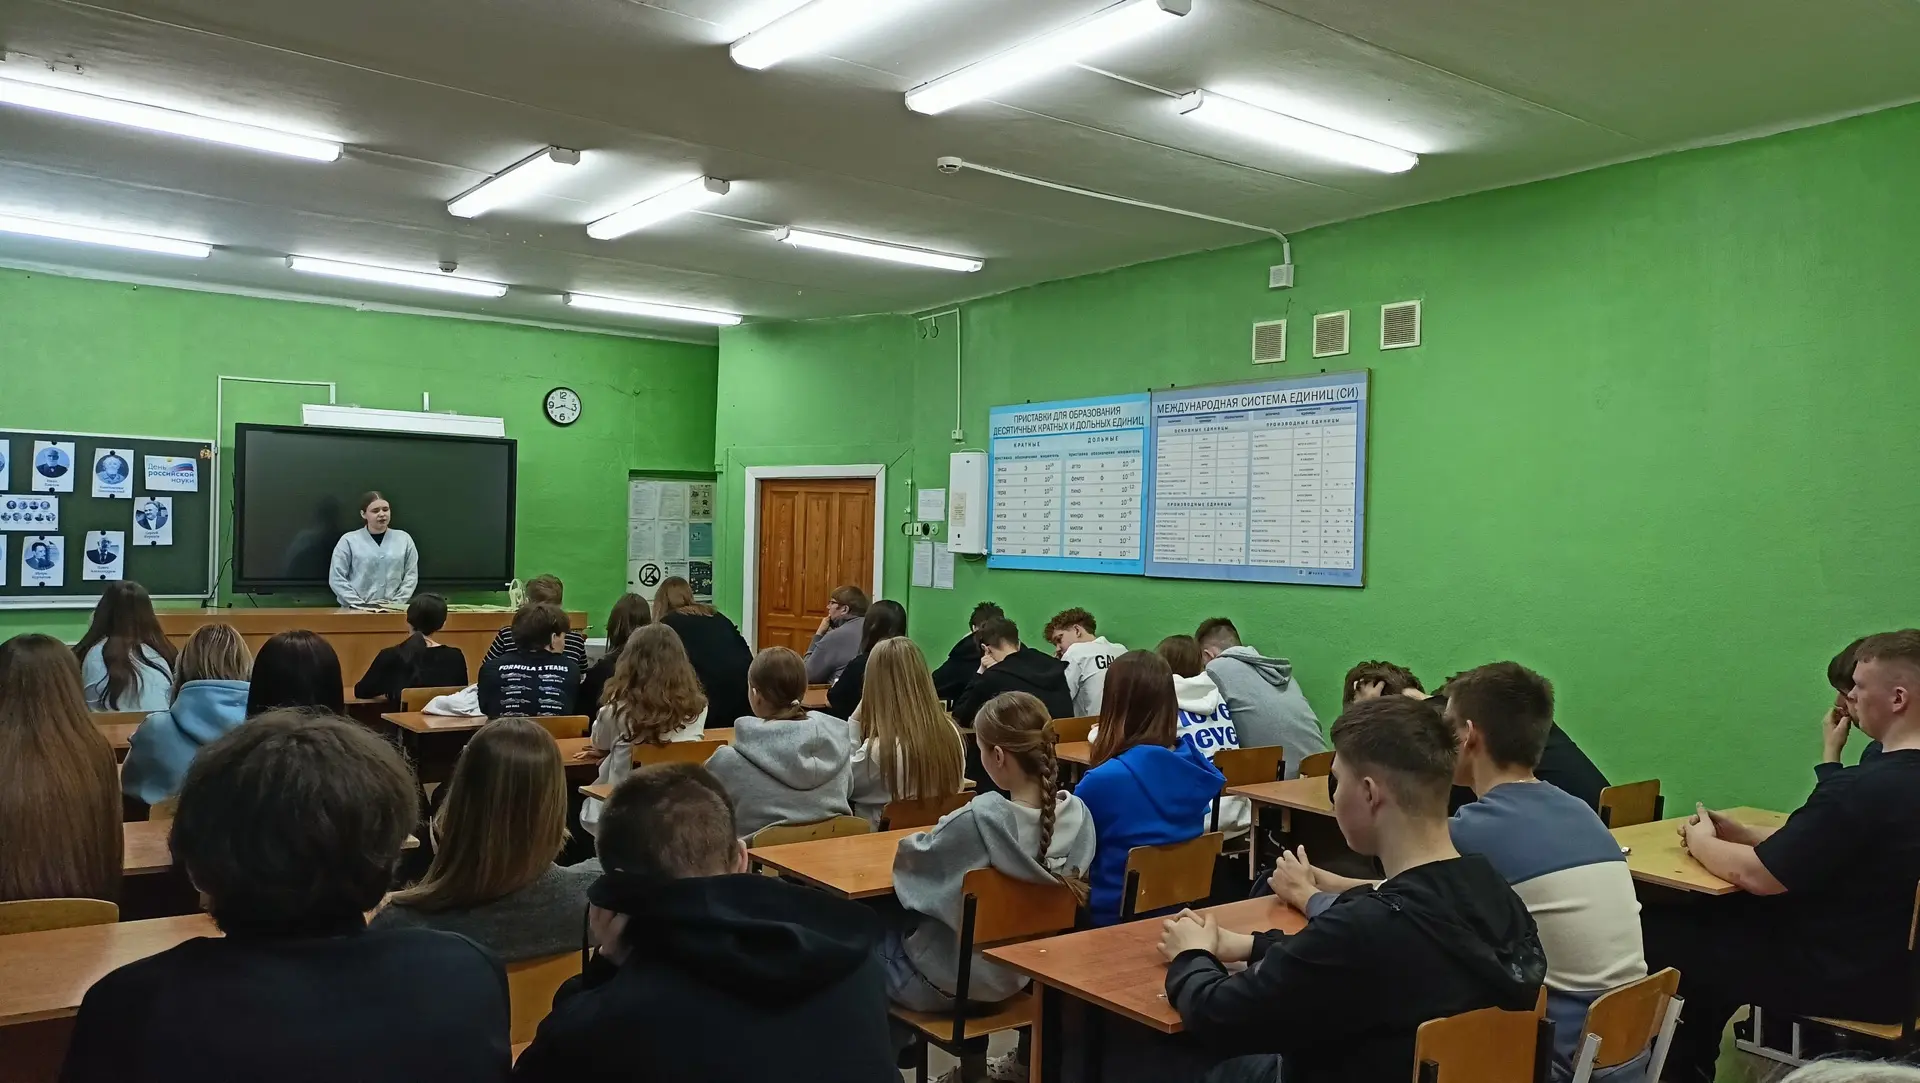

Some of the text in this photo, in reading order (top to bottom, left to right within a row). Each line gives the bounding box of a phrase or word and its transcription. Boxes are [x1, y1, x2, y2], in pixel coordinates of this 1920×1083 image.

[560, 391, 567, 399] 12
[1157, 387, 1358, 414] МЕЖДУНАРОДНАЯ СИСТЕМА ЕДИНИЦ (СИ)
[549, 401, 554, 409] 9
[559, 413, 565, 421] 6
[1014, 406, 1121, 423] ПРИСТАВКИ ДЛЯ ОБРАЗОВАНИЯ
[993, 416, 1144, 436] ДЕСЯТИЧНЫХ КРАТНЫХ И ДОЛЬНЫХ ЕДИНИЦ
[1087, 436, 1119, 444] ДОЛЬНЫЕ
[544, 665, 569, 673] TEAMS
